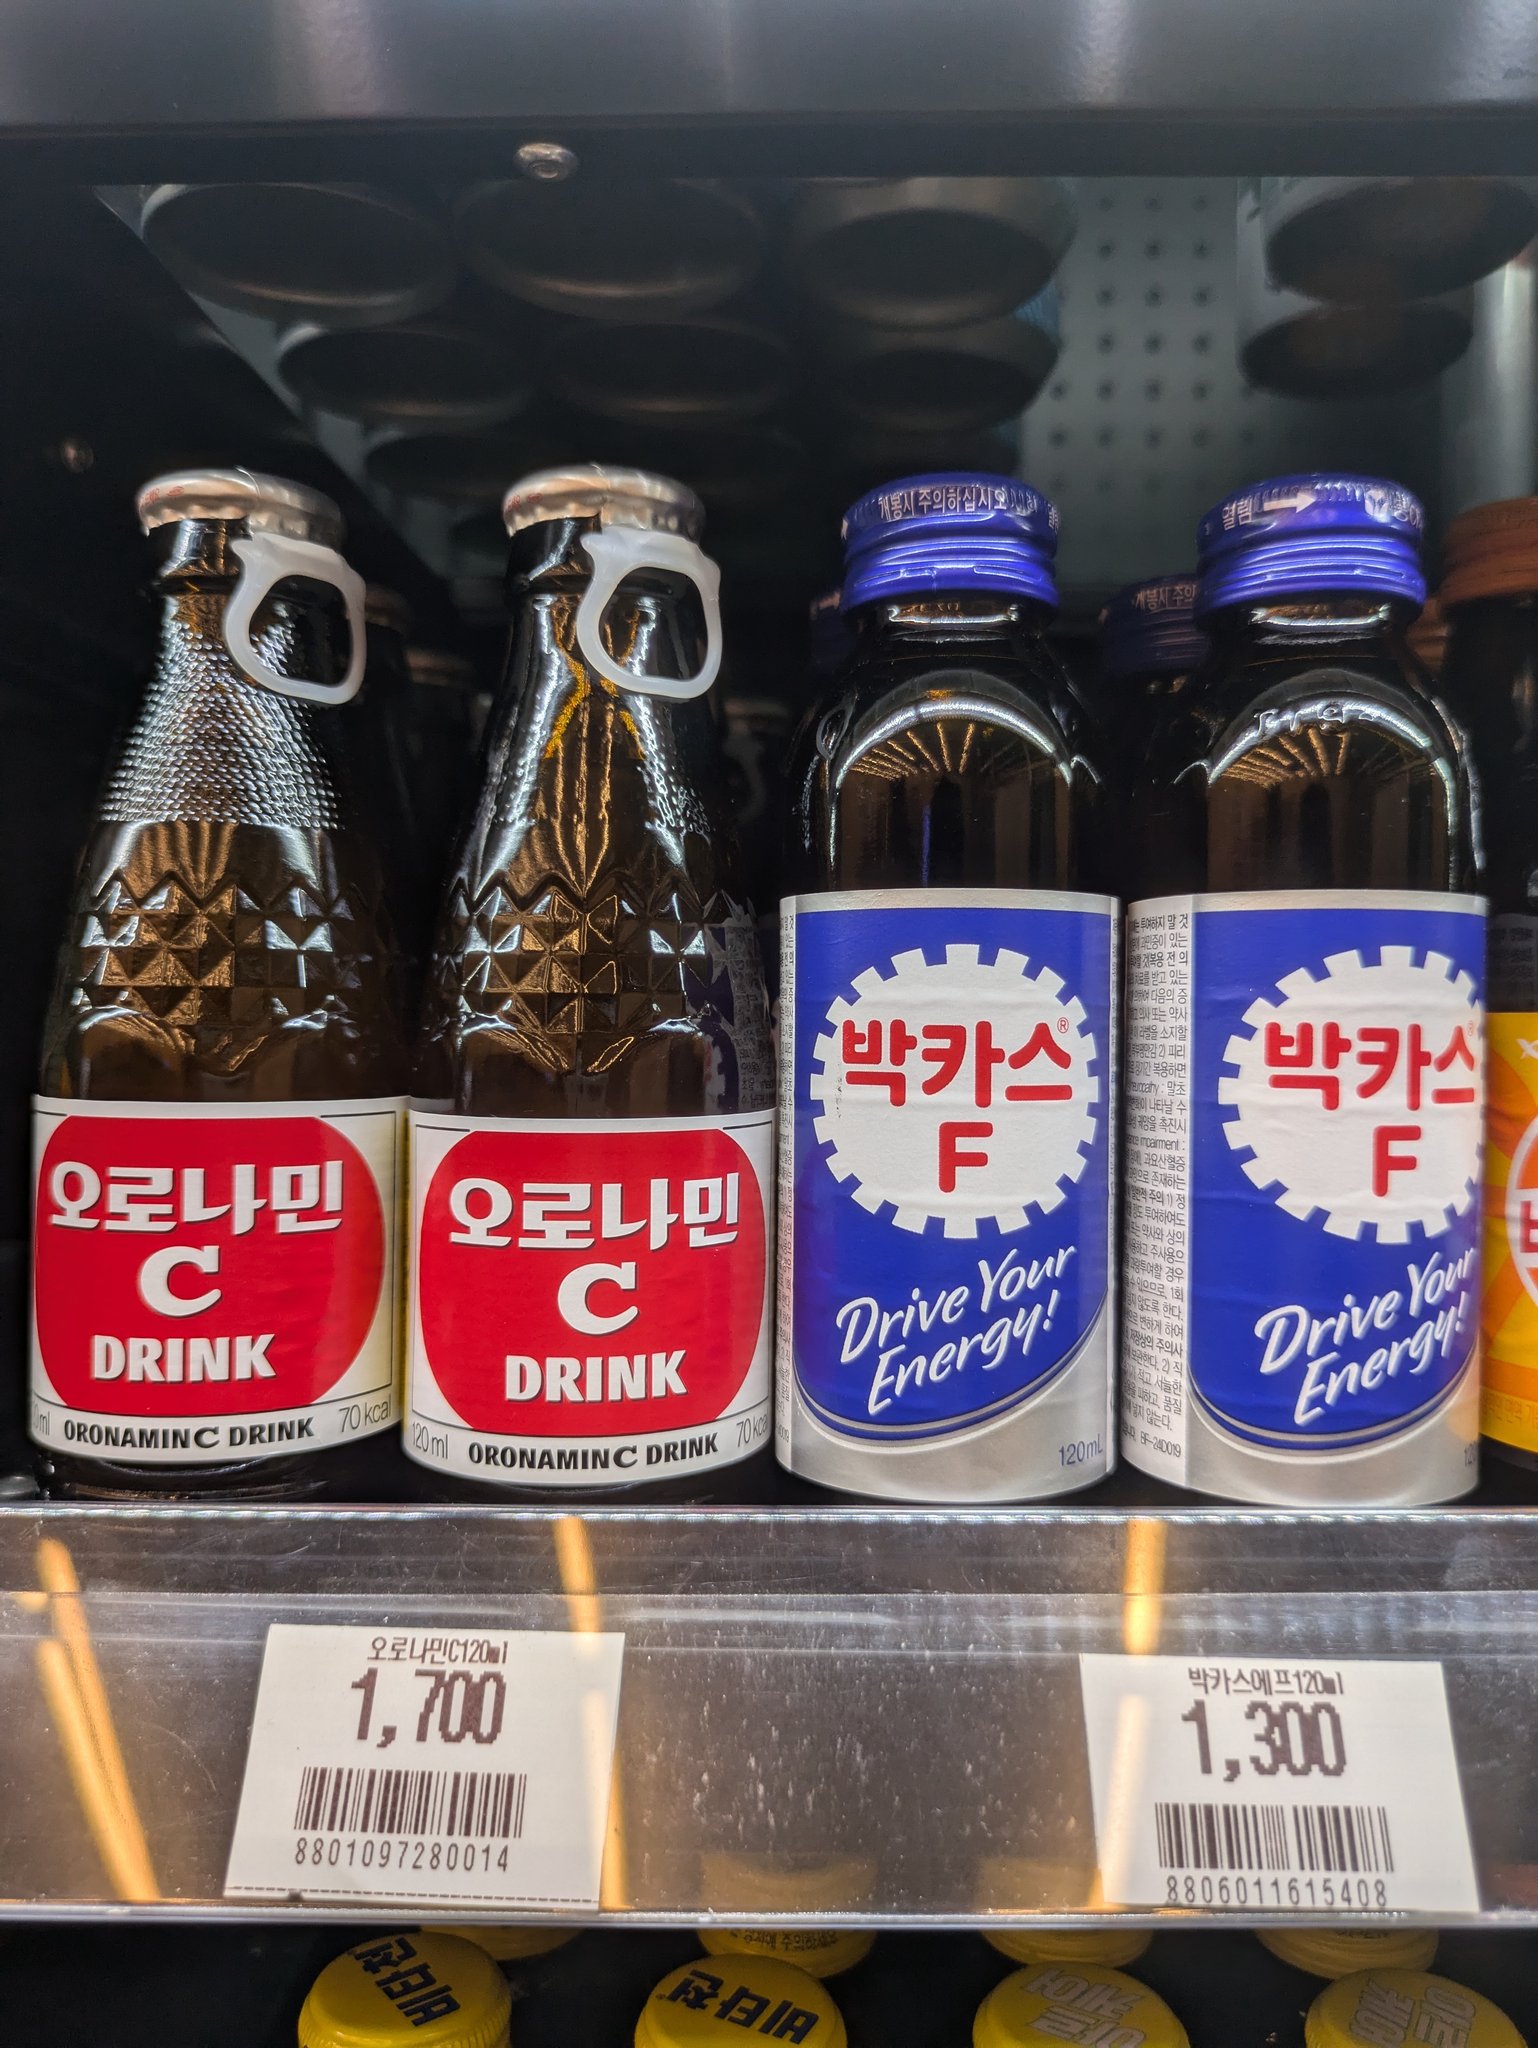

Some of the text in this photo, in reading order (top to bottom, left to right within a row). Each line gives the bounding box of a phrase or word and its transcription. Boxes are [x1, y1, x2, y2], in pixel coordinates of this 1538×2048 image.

[878, 486, 1008, 520] 개봉시 주의하십시오
[843, 1019, 1073, 1108] 박카스
[1264, 1022, 1475, 1111] 박카스
[939, 1122, 993, 1193] F
[1372, 1125, 1422, 1197] F
[49, 1160, 344, 1235] 오로나민
[449, 1172, 740, 1251] 오로나민
[139, 1244, 222, 1318] C
[557, 1261, 640, 1336] C
[836, 1287, 969, 1364] Drive
[978, 1245, 1076, 1313] Your
[1254, 1247, 1475, 1375] Drive Your
[91, 1333, 277, 1382] DRINK
[505, 1350, 687, 1403] DRINK
[867, 1289, 1060, 1416] Energy!
[1294, 1291, 1469, 1426] Energy!
[228, 1417, 315, 1447] DRINK
[338, 1409, 361, 1433] 70
[645, 1431, 719, 1465] DRINK
[350, 1666, 507, 1749] 1,700
[1181, 1699, 1348, 1783] 1,300
[294, 1836, 510, 1873] 8801097280014
[1166, 1874, 1388, 1907] 8806011615408
